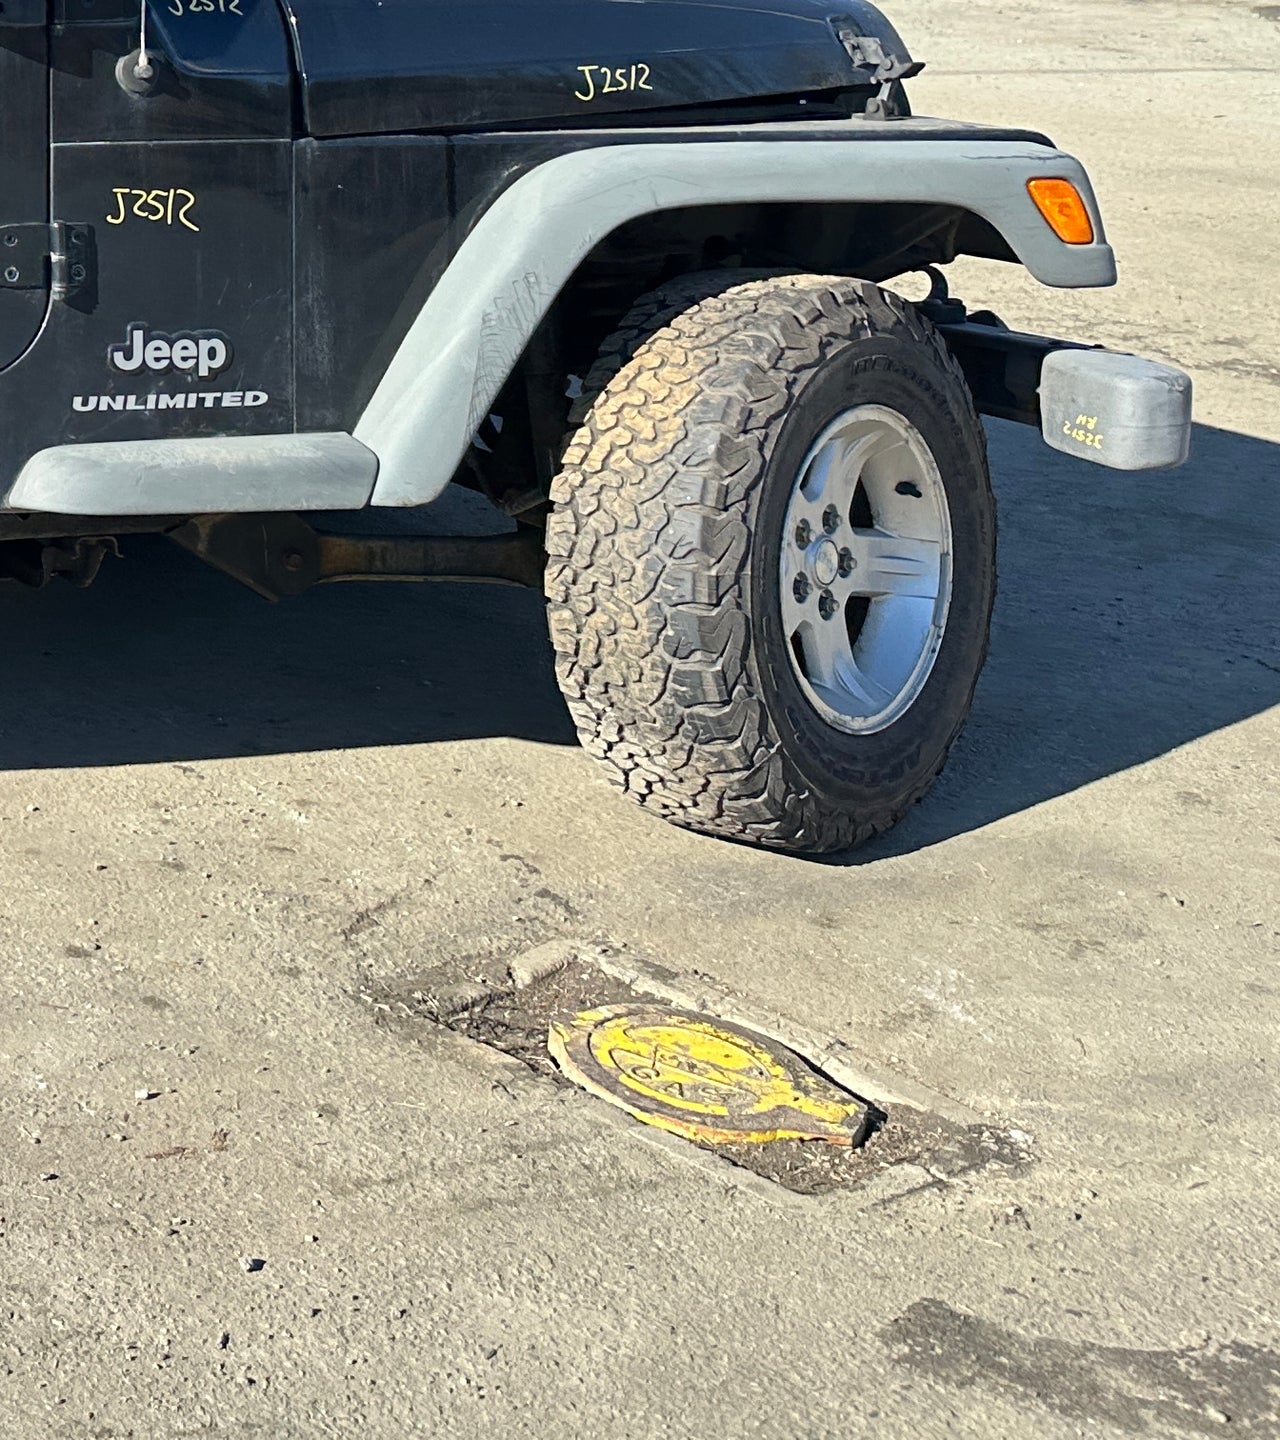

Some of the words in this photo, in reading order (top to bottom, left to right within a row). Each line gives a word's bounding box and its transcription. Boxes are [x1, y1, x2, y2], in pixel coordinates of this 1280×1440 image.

[575, 63, 653, 101] J2512
[106, 188, 200, 231] J2512
[113, 329, 227, 377] Jeep
[72, 390, 269, 412] UNLIMITED
